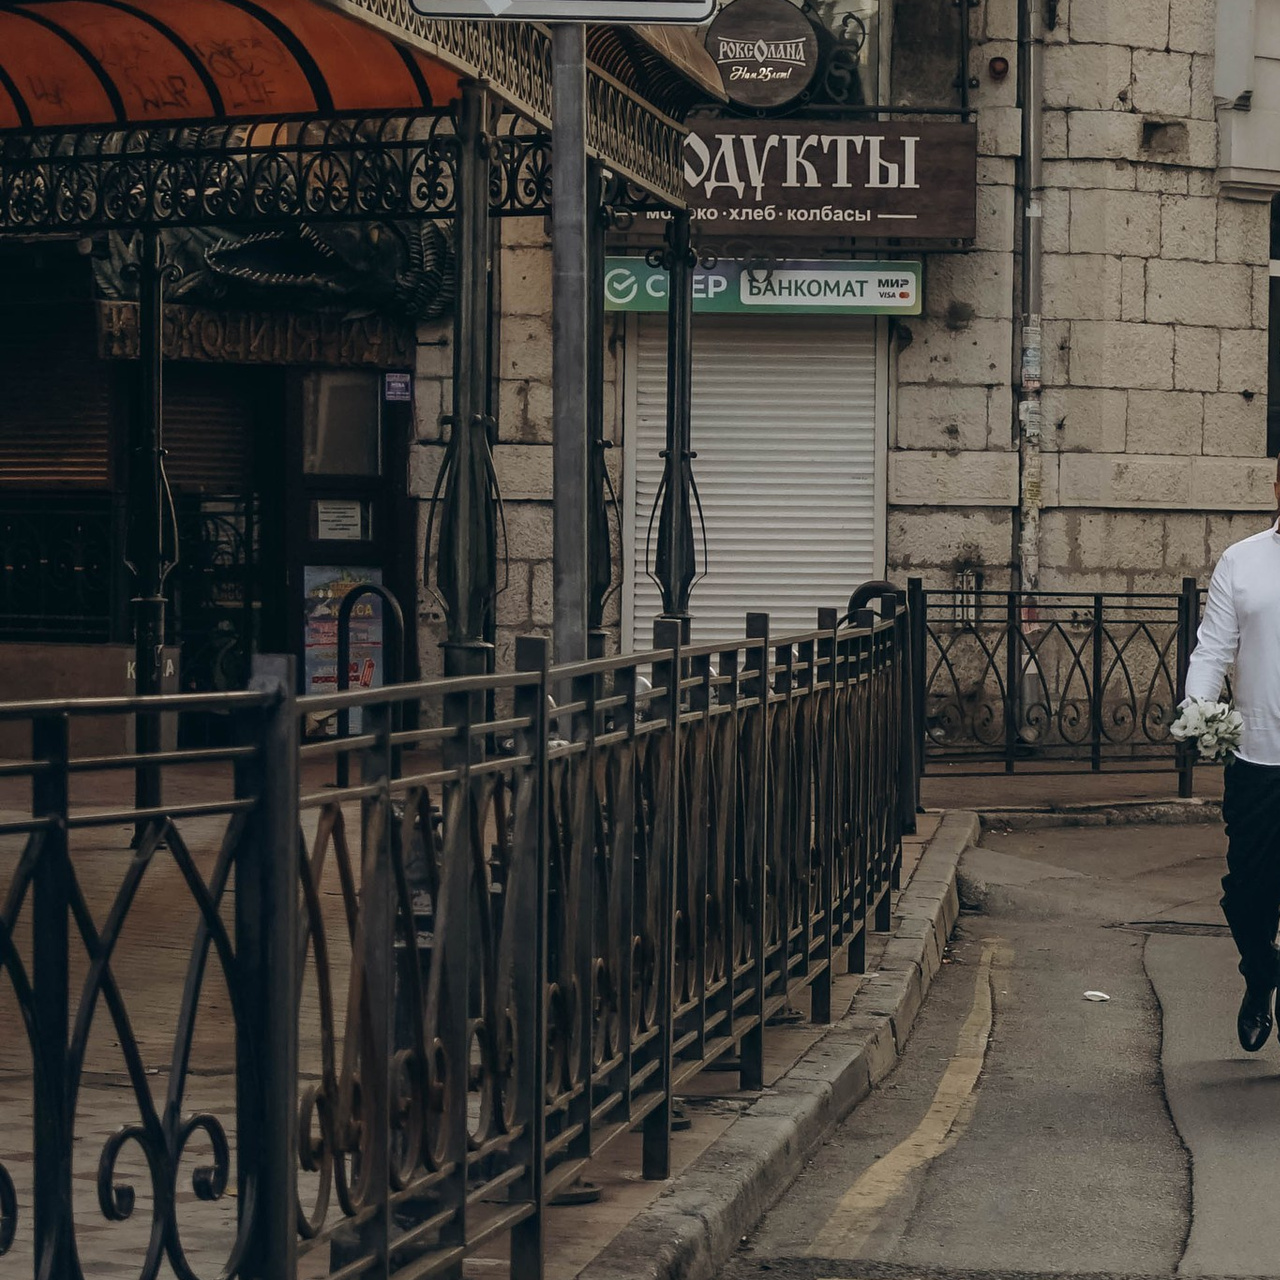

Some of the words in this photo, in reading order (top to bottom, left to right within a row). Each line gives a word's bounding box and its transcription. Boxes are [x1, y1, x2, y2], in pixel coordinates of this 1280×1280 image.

[718, 39, 806, 63] РОКСОЛАНА
[729, 66, 757, 81] Нам
[757, 67, 773, 82] 25
[684, 132, 920, 201] ОДУКТЫ
[728, 205, 776, 221] хлеб
[787, 205, 871, 222] колбасы
[645, 274, 728, 298] СЕР
[748, 279, 869, 298] БАНКОМАТ
[877, 278, 909, 288] МИР
